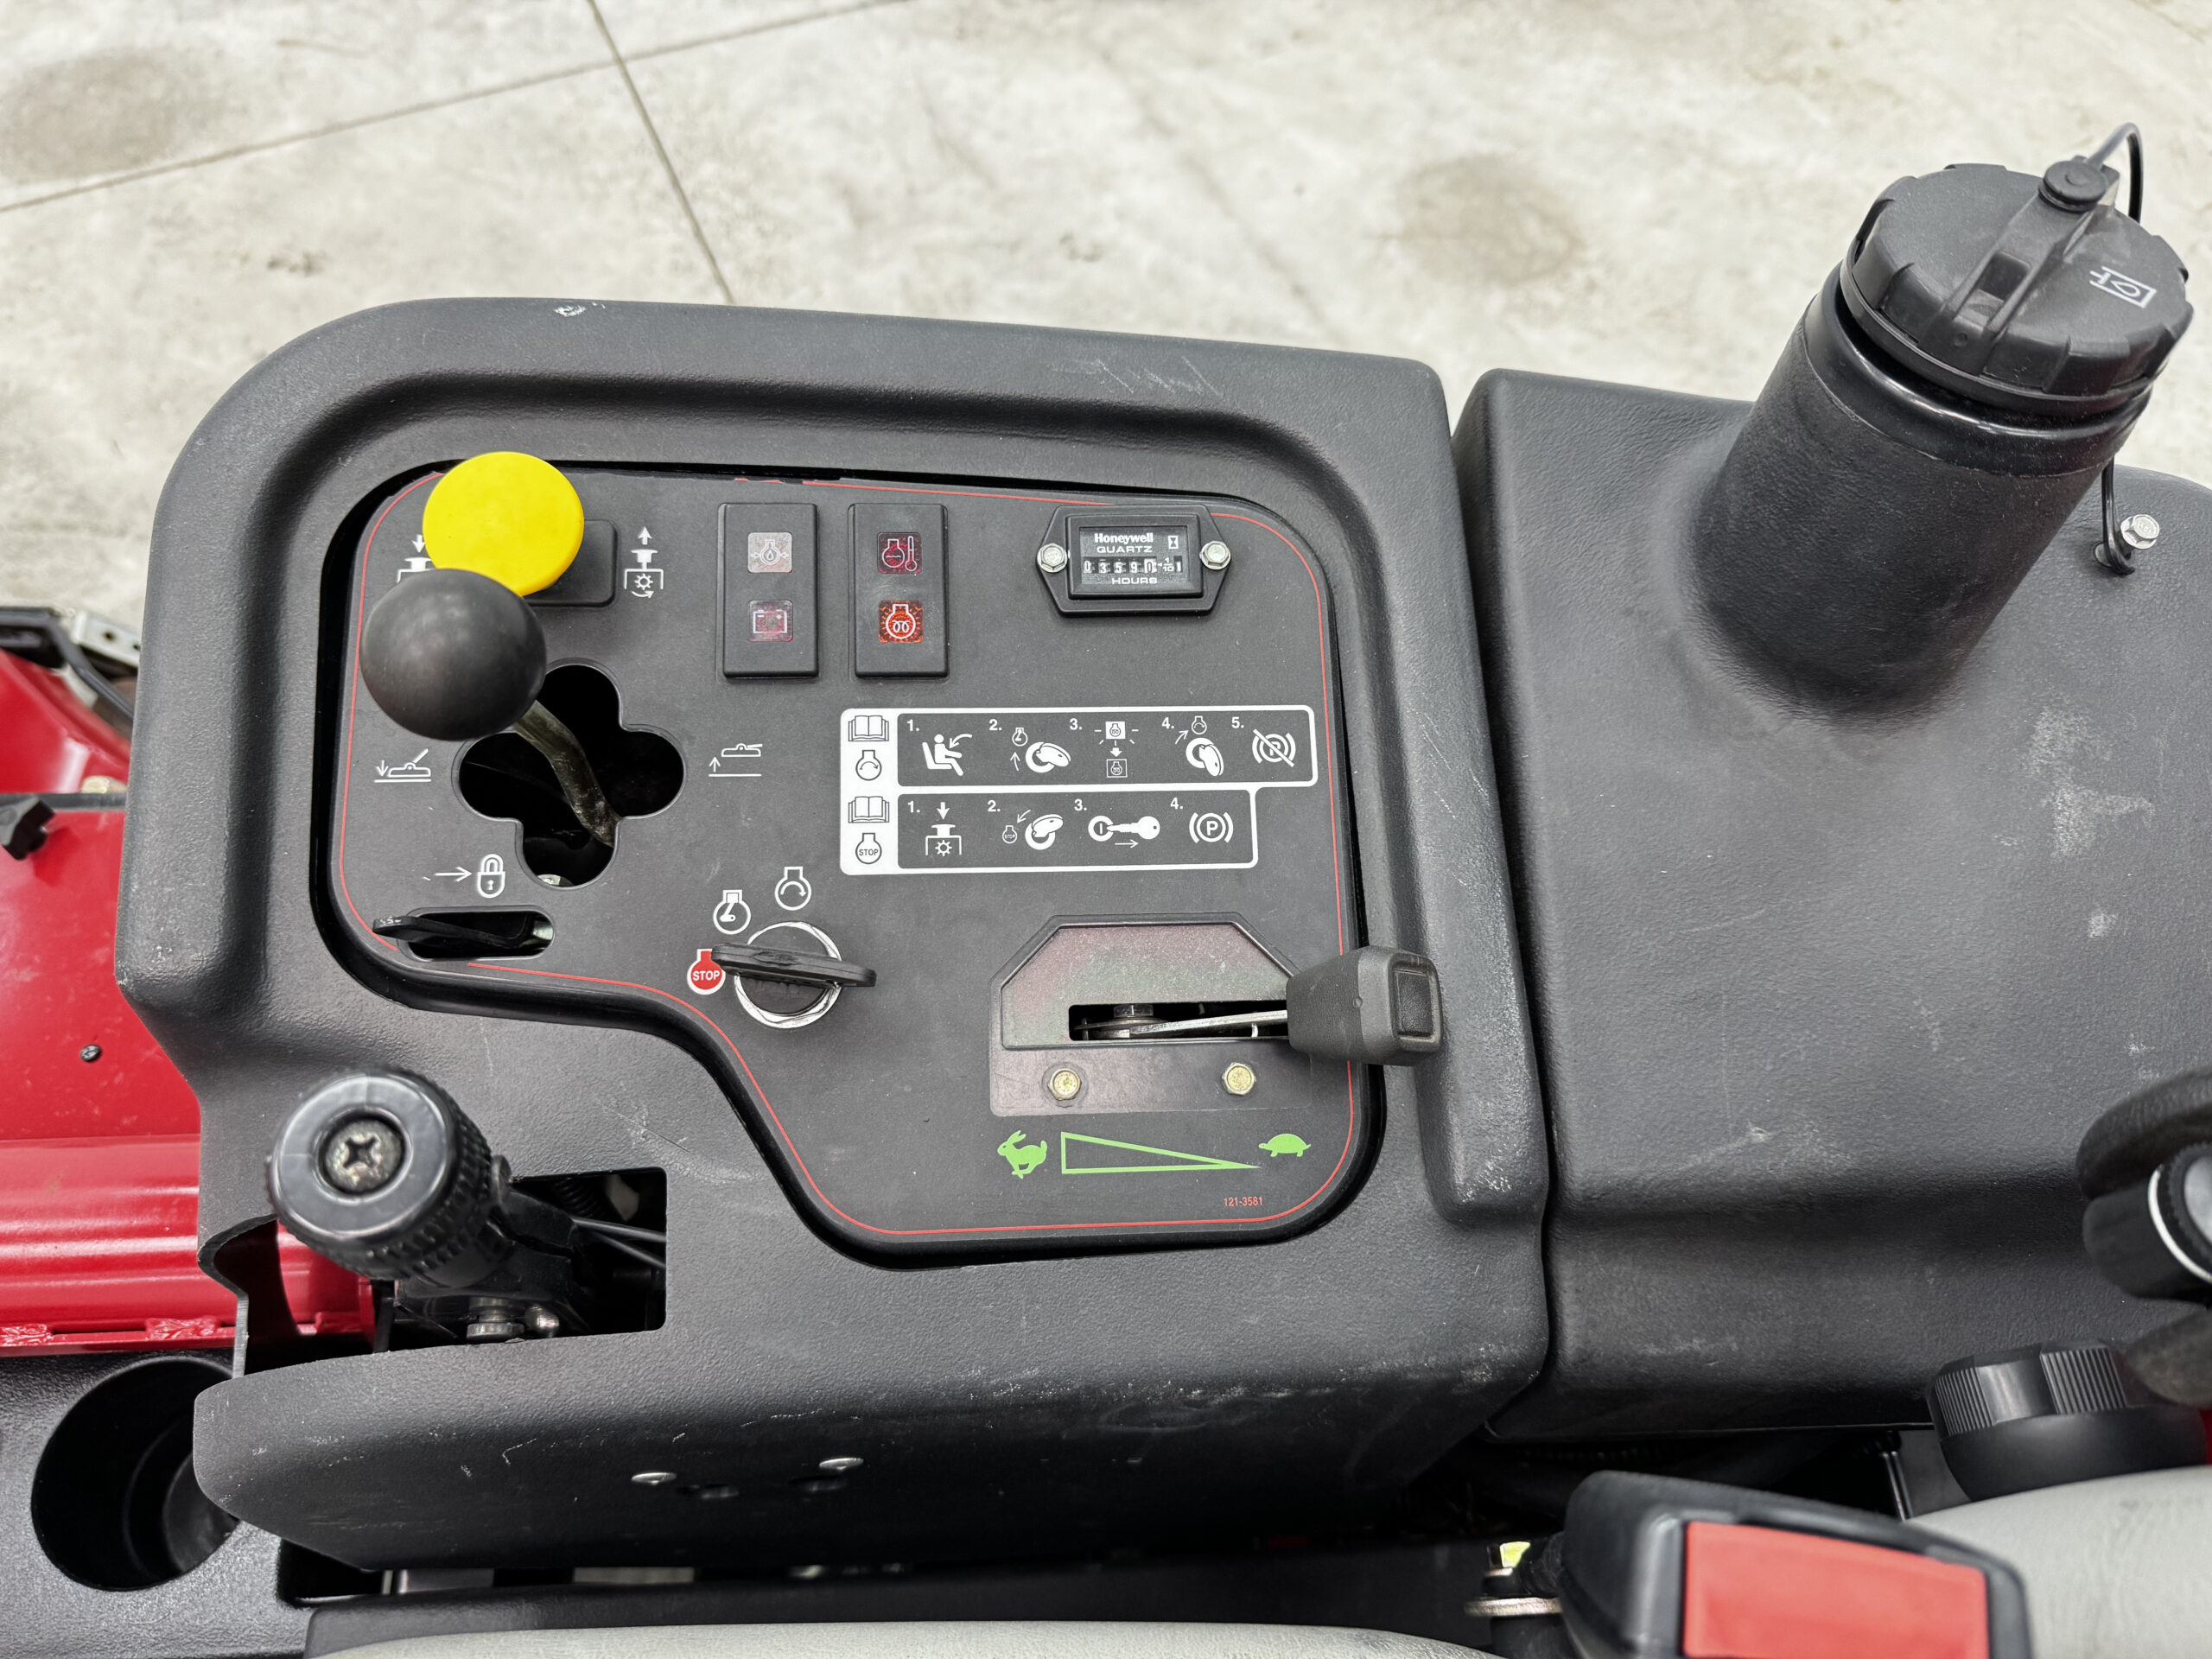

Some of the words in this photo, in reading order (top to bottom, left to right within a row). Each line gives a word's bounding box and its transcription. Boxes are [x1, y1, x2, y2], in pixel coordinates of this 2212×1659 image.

[1094, 532, 1154, 544] Honeywell
[1096, 545, 1153, 554] QUARTZ
[907, 719, 919, 731] 1.
[989, 719, 1002, 731] 2.
[1070, 718, 1083, 730] 3.
[1161, 716, 1175, 729] 4.
[1231, 716, 1244, 728] 5.
[907, 801, 920, 813] 1.
[988, 800, 1001, 812] 2.
[1075, 799, 1087, 811] 3.
[1170, 798, 1183, 810] 4.
[692, 969, 721, 982] STOP
[1224, 1196, 1263, 1207] 121-3581
